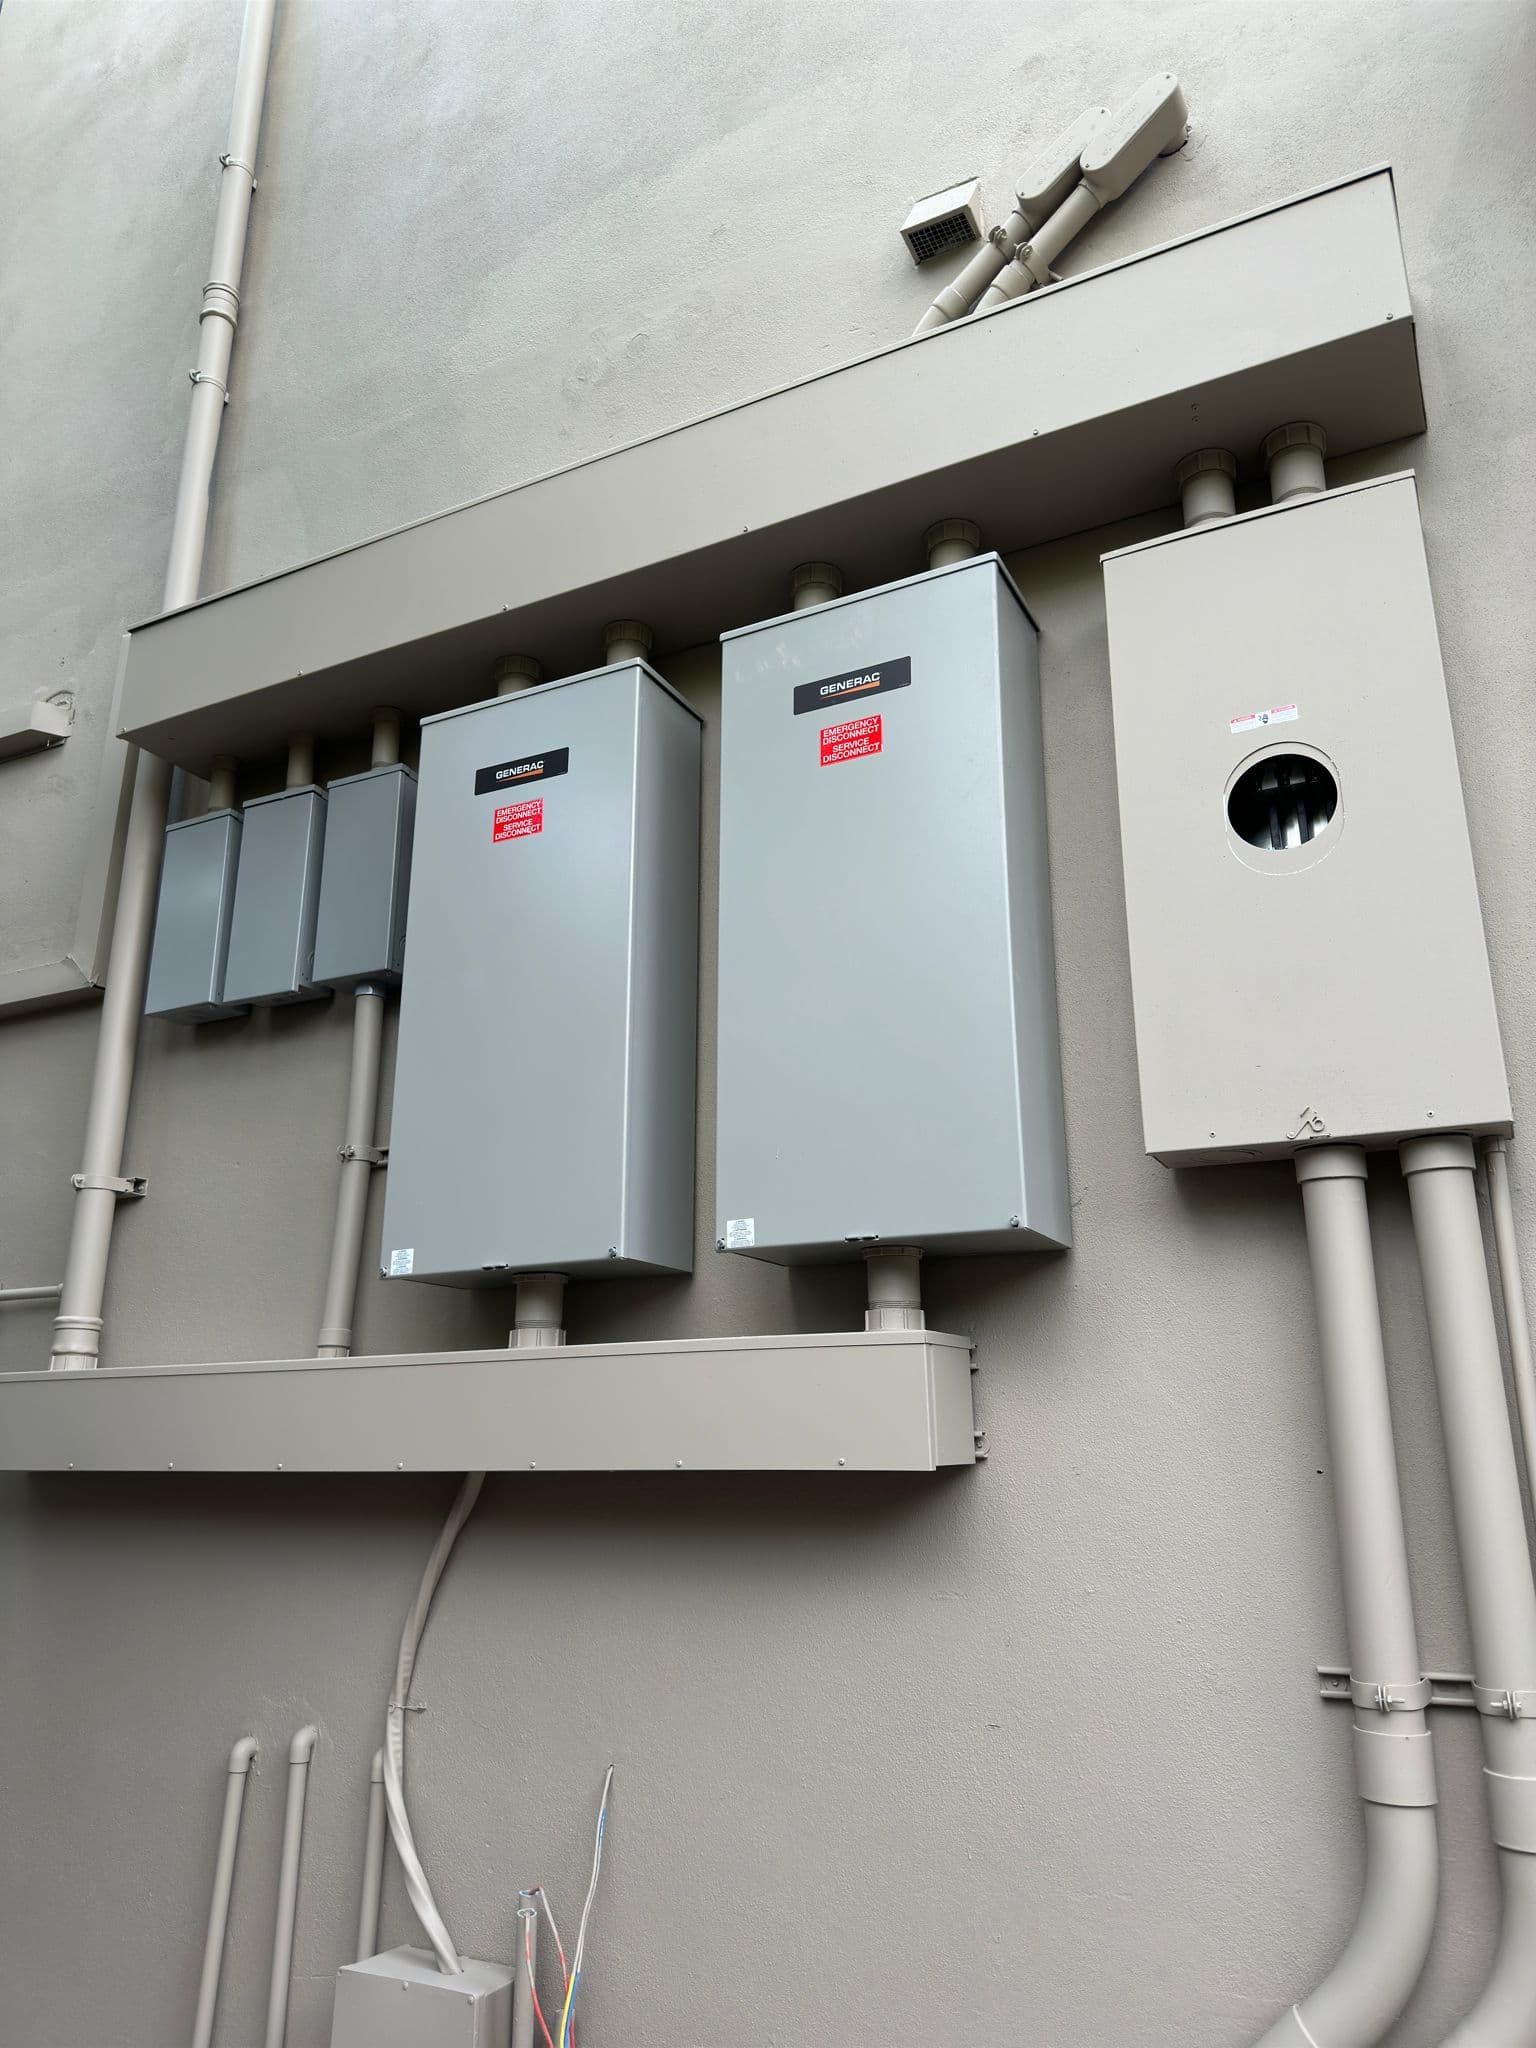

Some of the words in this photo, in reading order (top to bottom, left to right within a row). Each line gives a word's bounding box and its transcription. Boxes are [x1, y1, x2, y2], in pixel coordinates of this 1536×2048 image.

[820, 672, 880, 696] GENERAC
[822, 724, 879, 745] DISCONNECT
[824, 717, 879, 737] EMERGENCY
[823, 742, 879, 763] DISCONNECT
[832, 737, 869, 753] SERVICE
[496, 761, 544, 779] GENERAC
[496, 808, 541, 824] DISCONNECT
[497, 801, 541, 817] EMERGENCY
[495, 824, 540, 840] DISCONNECT
[503, 819, 533, 831] SERVICE
